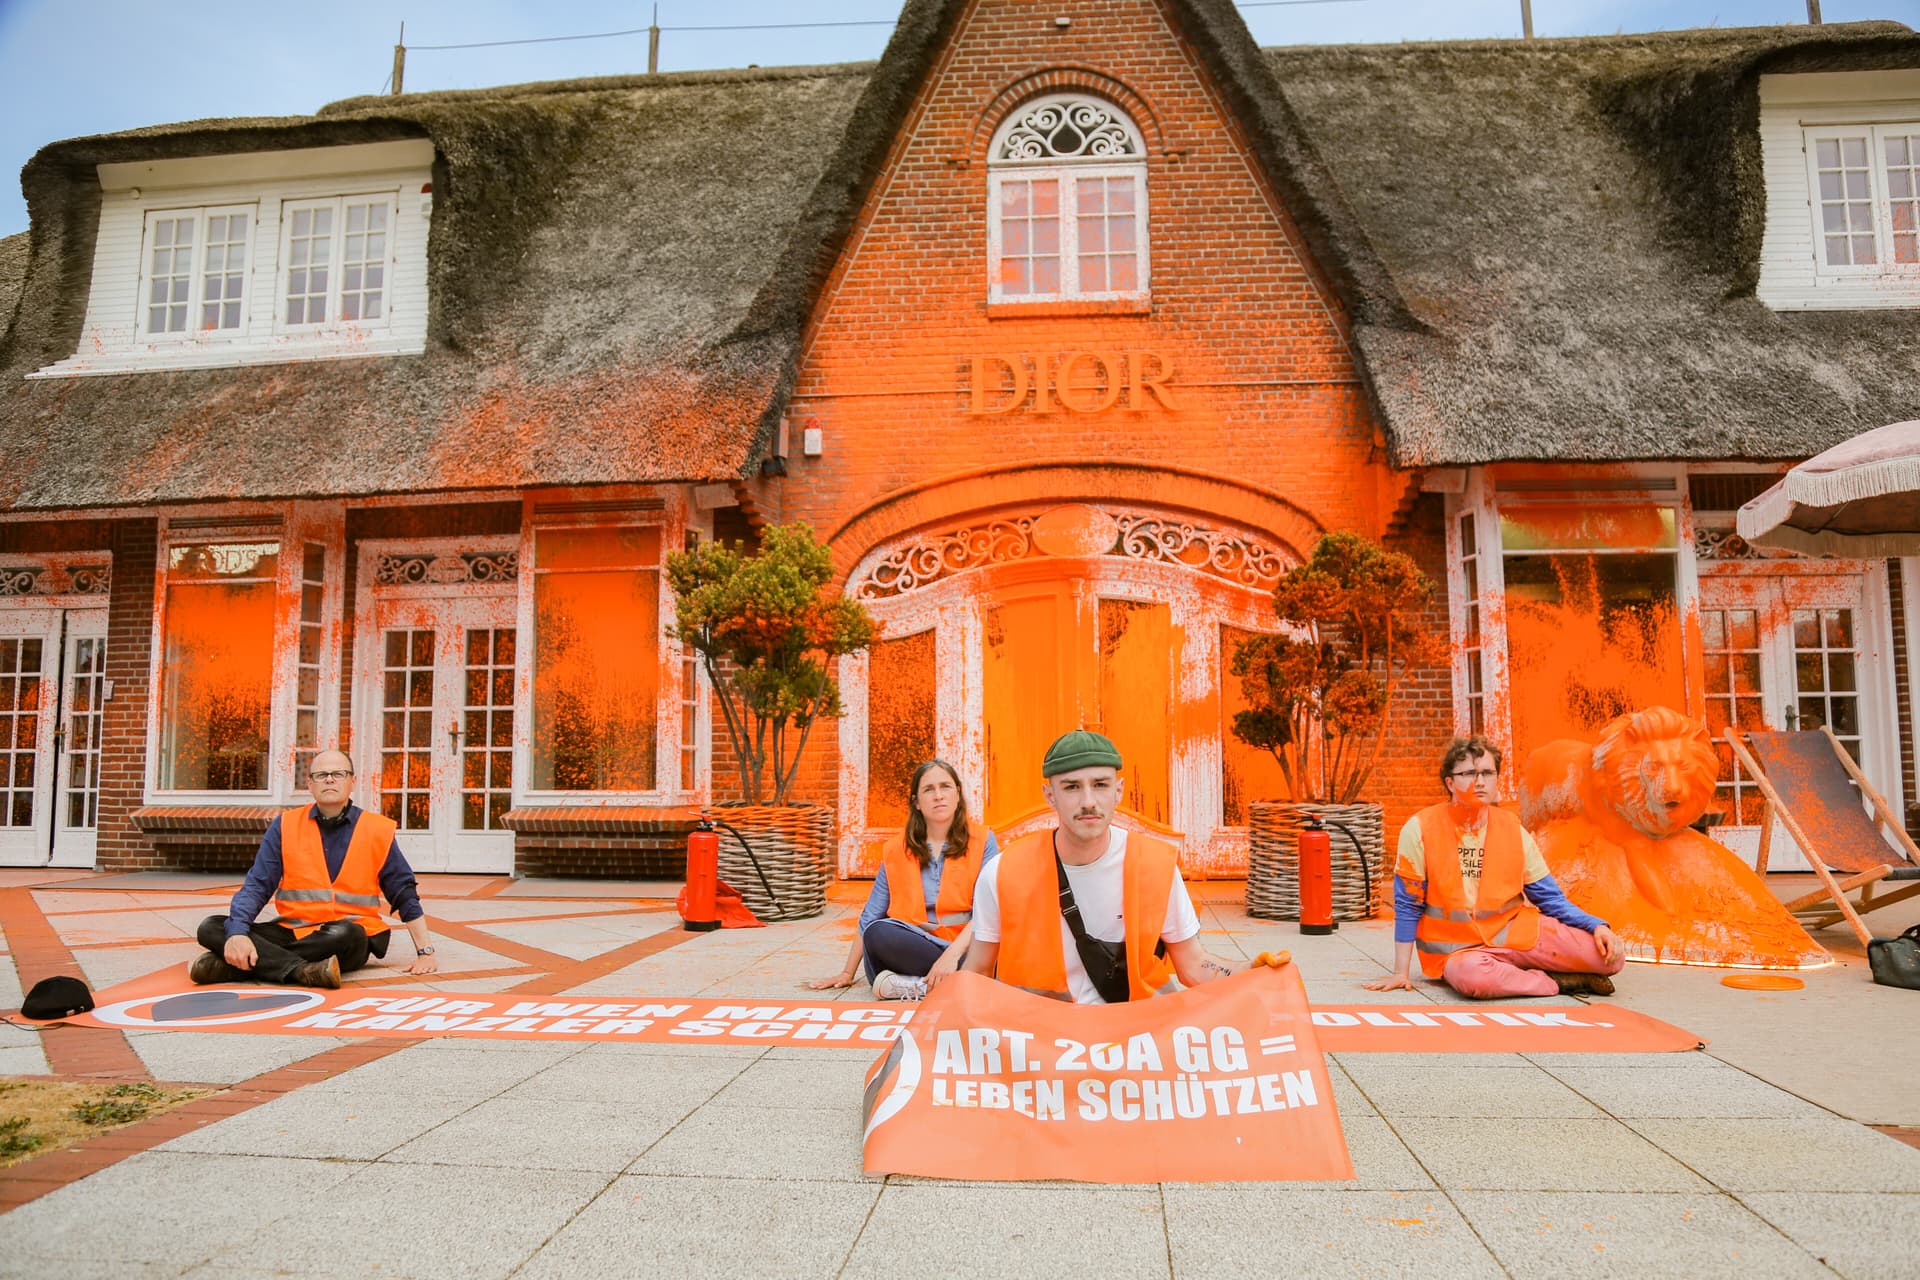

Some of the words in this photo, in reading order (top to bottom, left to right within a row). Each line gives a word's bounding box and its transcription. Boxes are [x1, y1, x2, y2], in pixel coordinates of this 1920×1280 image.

[963, 350, 1186, 415] DIOR
[1463, 859, 1483, 869] SILE
[331, 996, 495, 1015] FÜR
[502, 1001, 694, 1017] WEN
[281, 1012, 655, 1034] KANZLER
[667, 1020, 909, 1041] SCHO
[932, 1028, 1041, 1075] ART.
[1054, 1032, 1163, 1071] 20A
[1172, 1026, 1249, 1073] GG
[932, 1078, 1066, 1121] LEBEN
[1077, 1068, 1319, 1121] SCHÜTZEN
